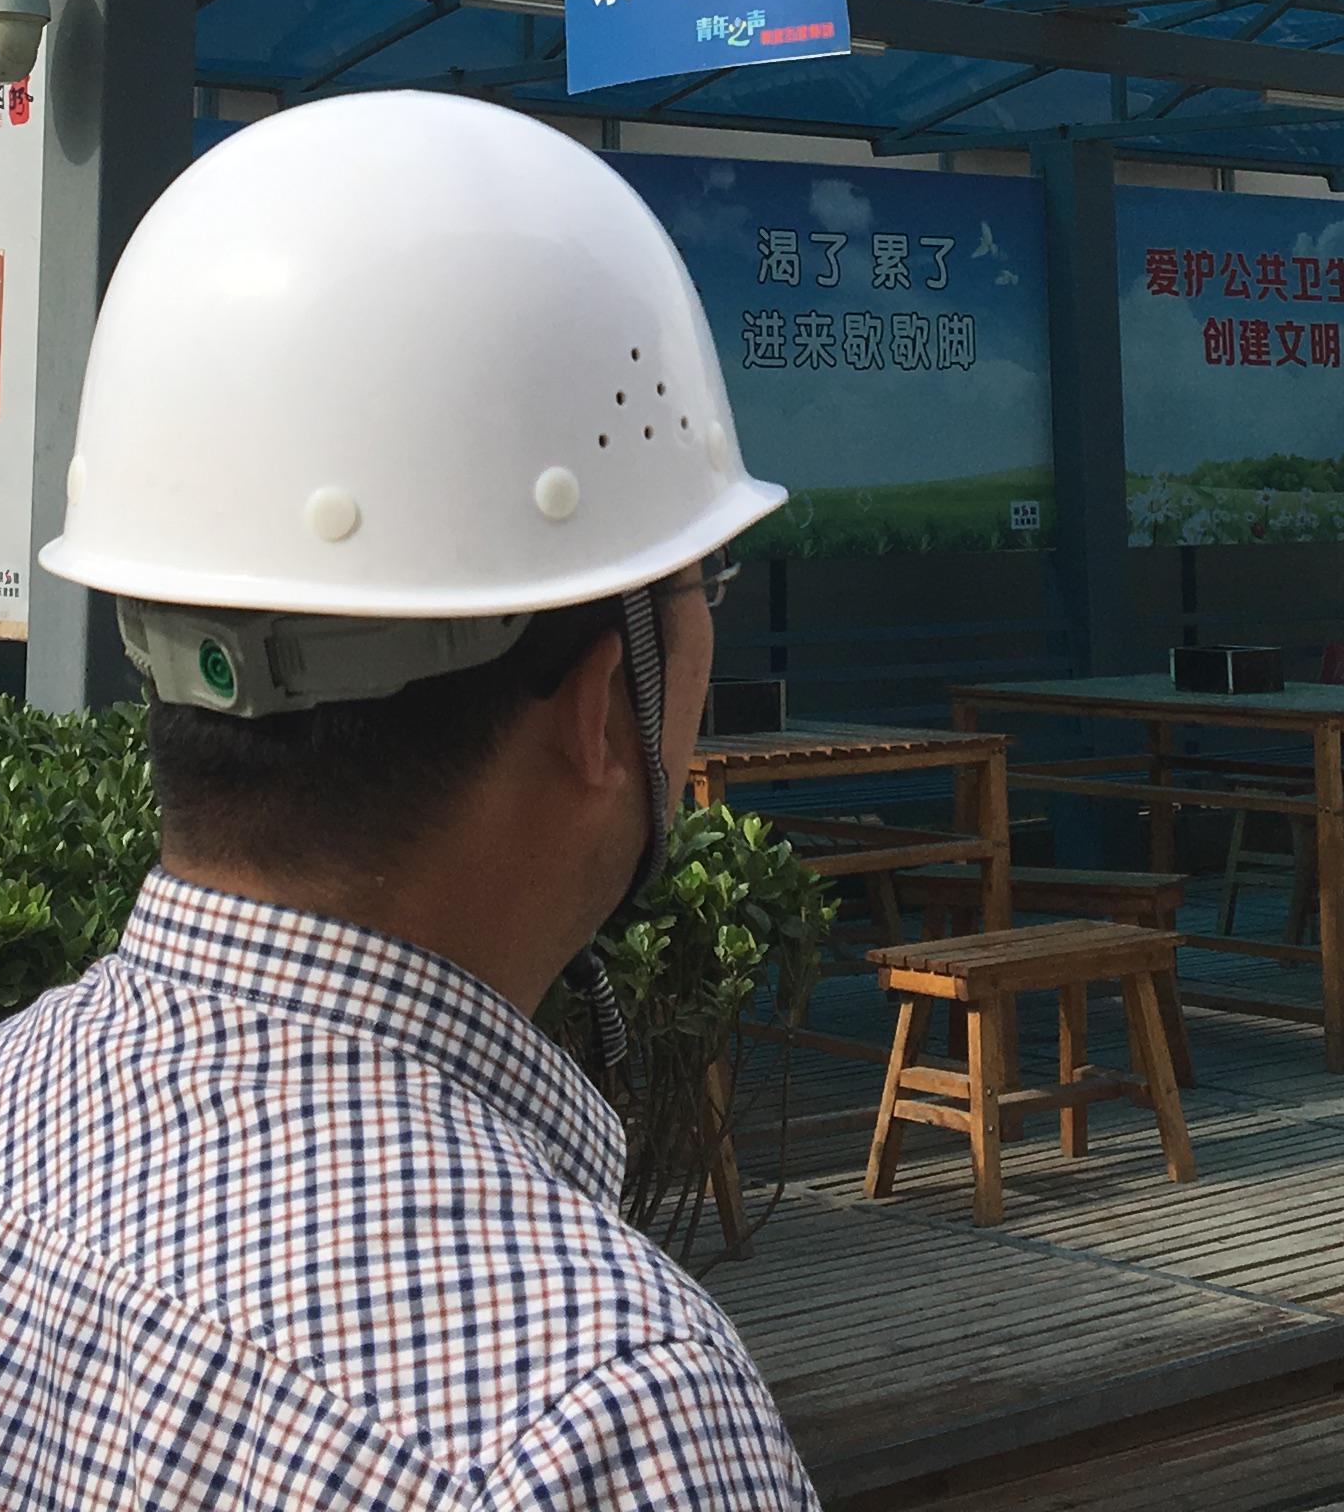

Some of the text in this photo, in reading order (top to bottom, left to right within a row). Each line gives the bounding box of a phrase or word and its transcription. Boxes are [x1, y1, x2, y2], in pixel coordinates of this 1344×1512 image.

[696, 9, 766, 47] 青年之声
[756, 227, 957, 292] 渴了 累了
[742, 309, 977, 371] 进来歇歇脚
